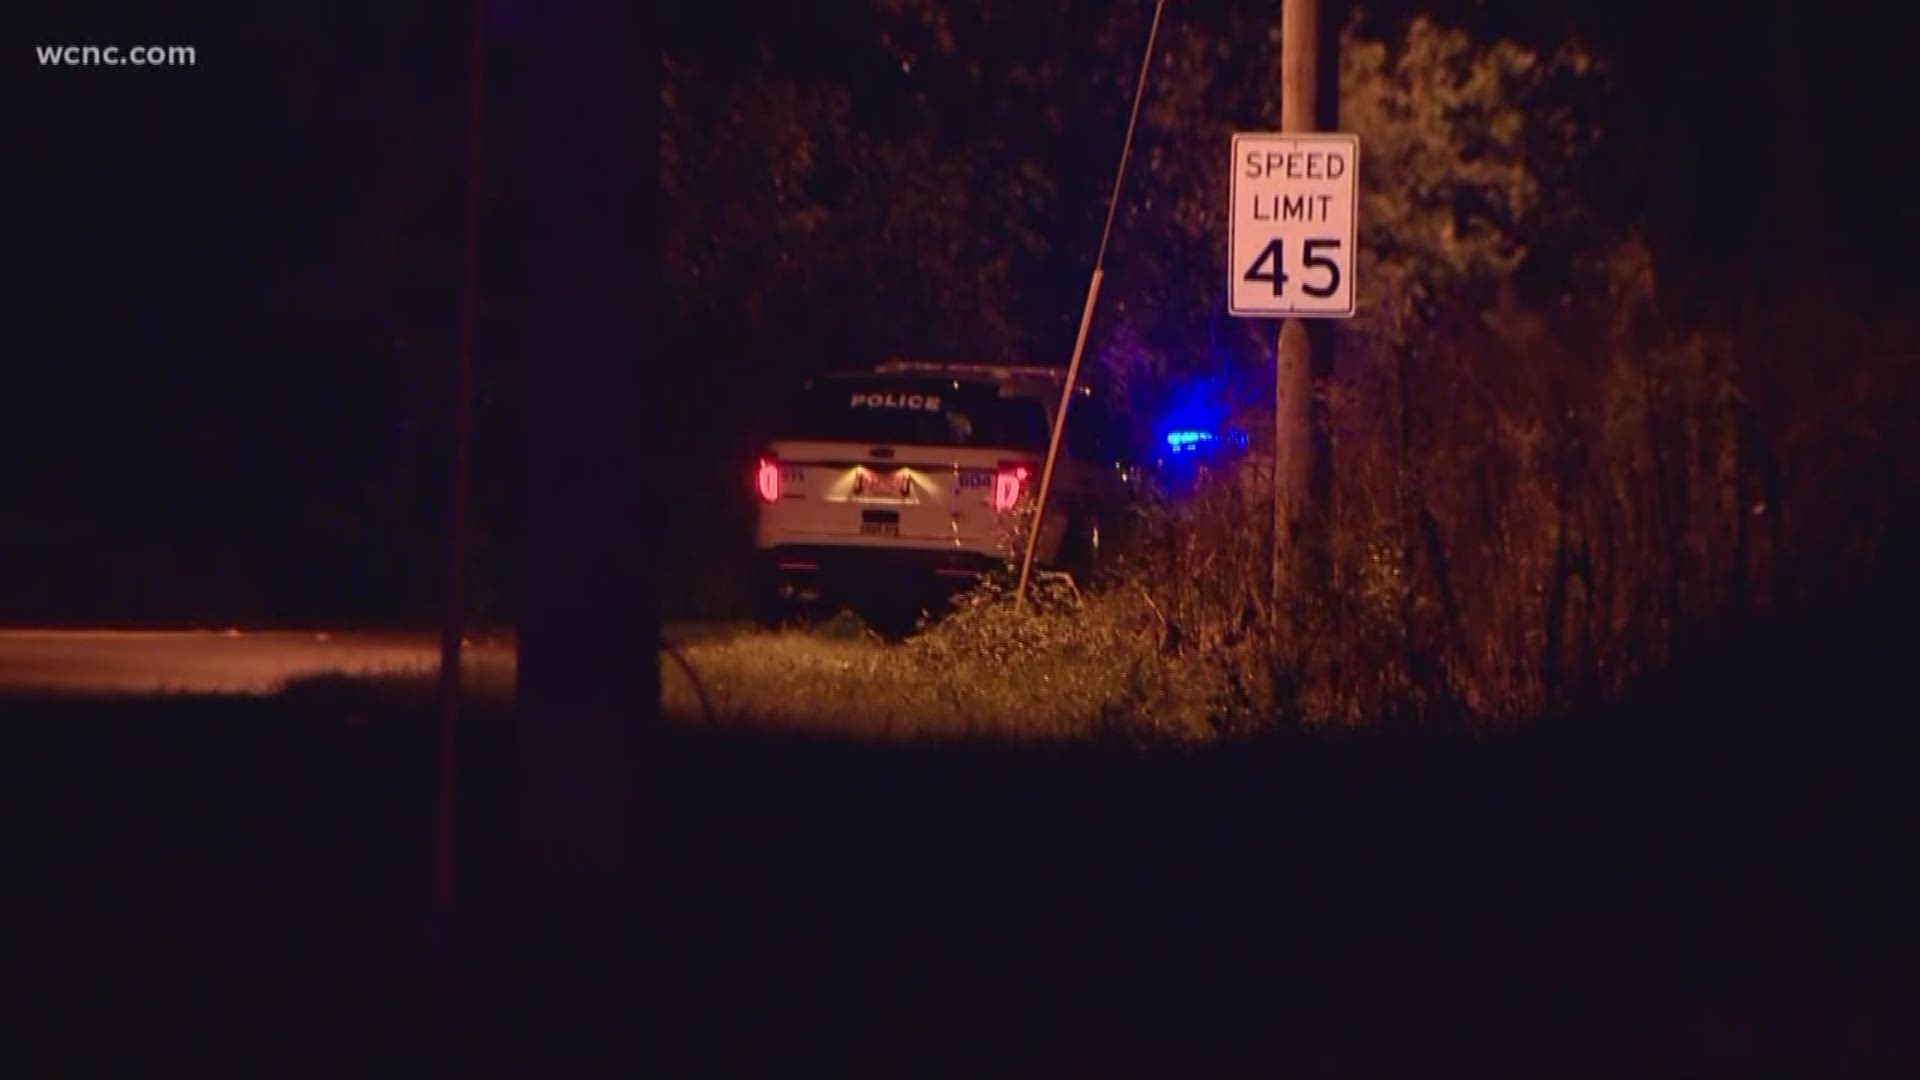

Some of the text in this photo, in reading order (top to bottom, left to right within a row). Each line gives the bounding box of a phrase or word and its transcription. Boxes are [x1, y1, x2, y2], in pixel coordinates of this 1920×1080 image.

[1245, 152, 1345, 179] SPEED
[1253, 194, 1333, 221] LIMIT
[1243, 238, 1342, 299] 45
[850, 392, 941, 411] POLICE
